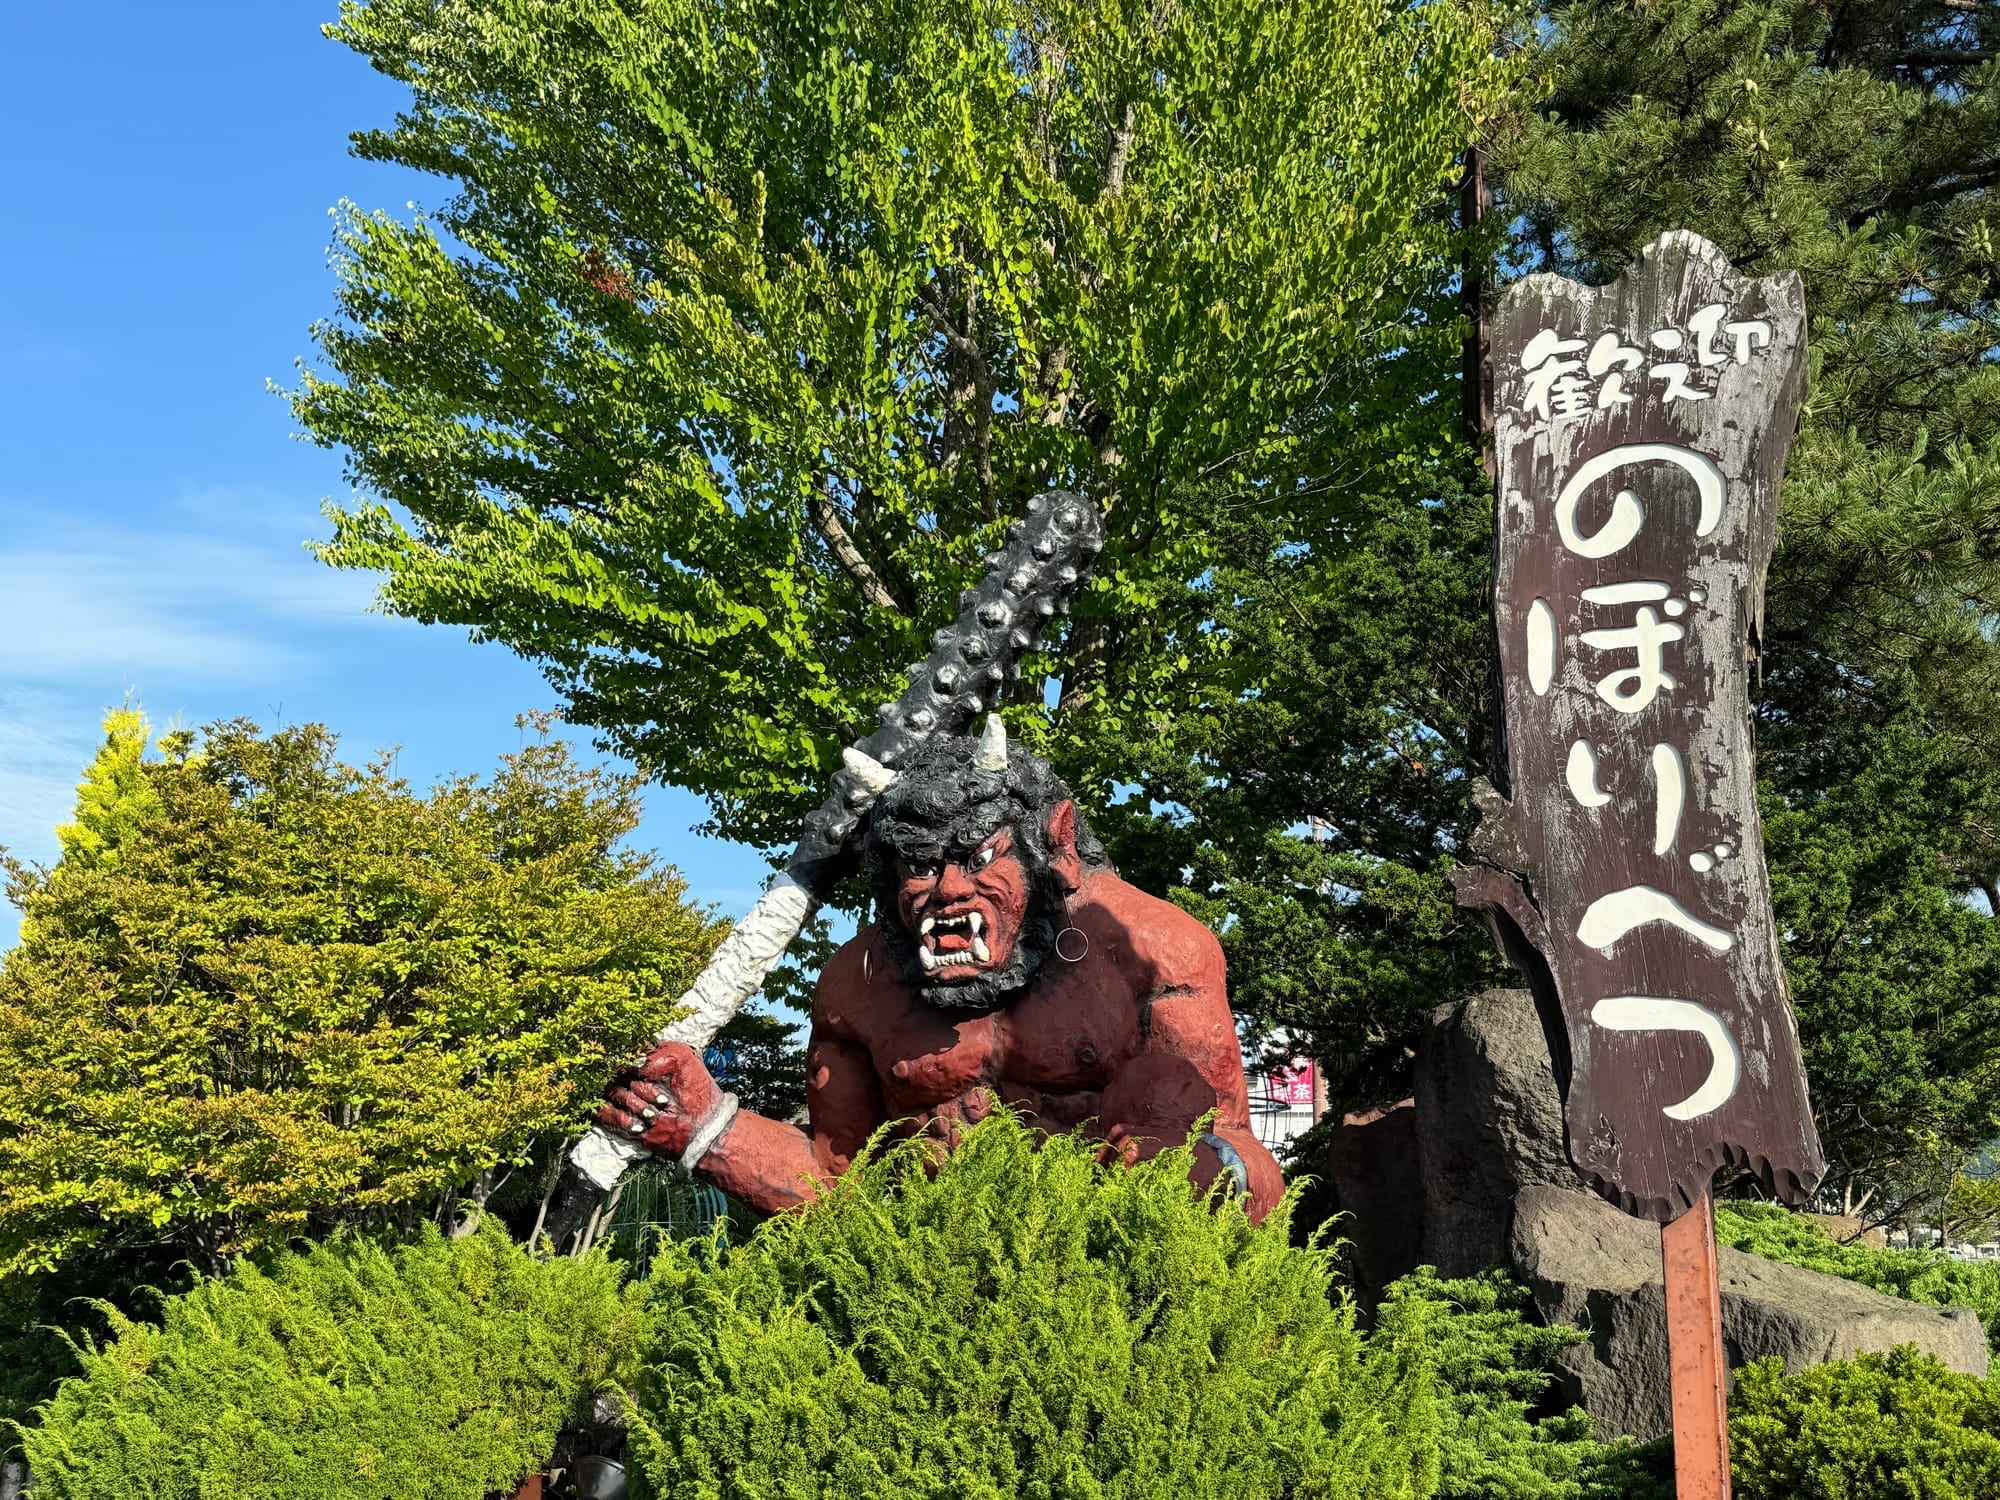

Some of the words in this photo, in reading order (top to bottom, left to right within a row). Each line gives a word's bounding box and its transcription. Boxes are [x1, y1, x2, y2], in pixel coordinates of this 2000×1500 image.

[1527, 443, 1738, 1121] のぼりべつ
